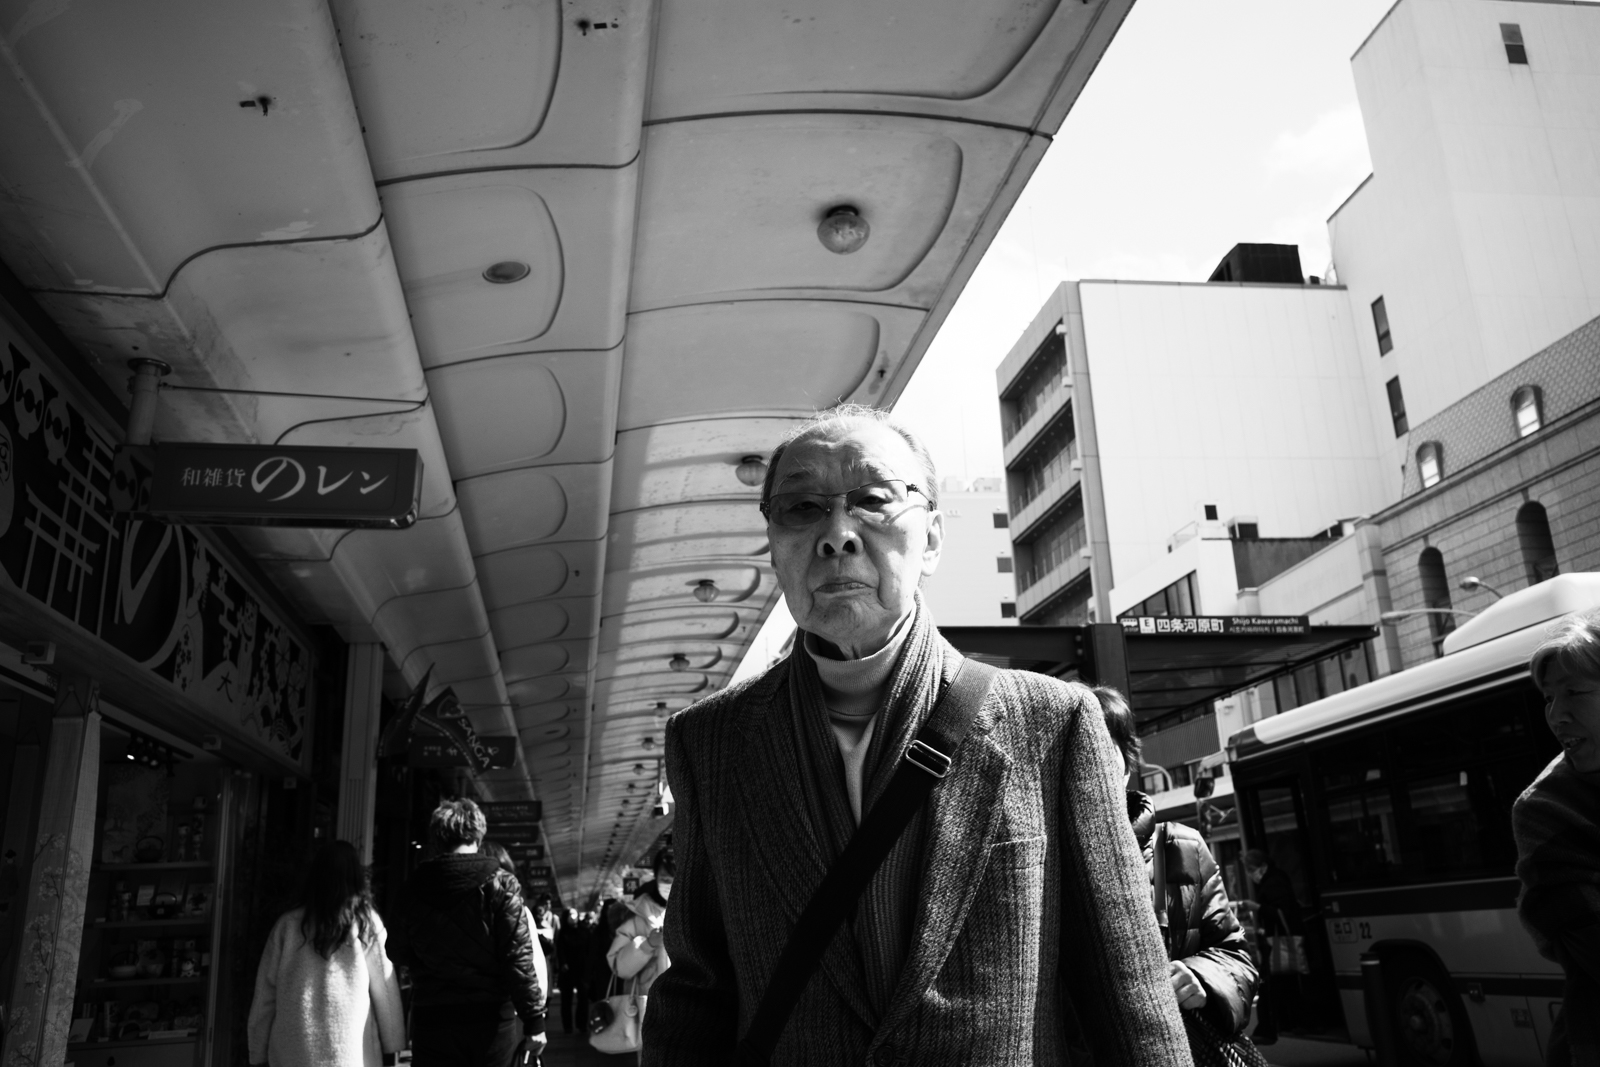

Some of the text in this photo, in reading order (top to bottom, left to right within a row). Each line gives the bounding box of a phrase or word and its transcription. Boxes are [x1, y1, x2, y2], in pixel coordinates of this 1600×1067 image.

[180, 456, 390, 502] 和雑貨 のレン
[1156, 618, 1224, 633] 四条河原町
[1231, 617, 1299, 626] Shijo Kawaramachi
[458, 718, 490, 768] SANGA
[1334, 922, 1352, 934] 出口
[1359, 922, 1372, 939] 22
